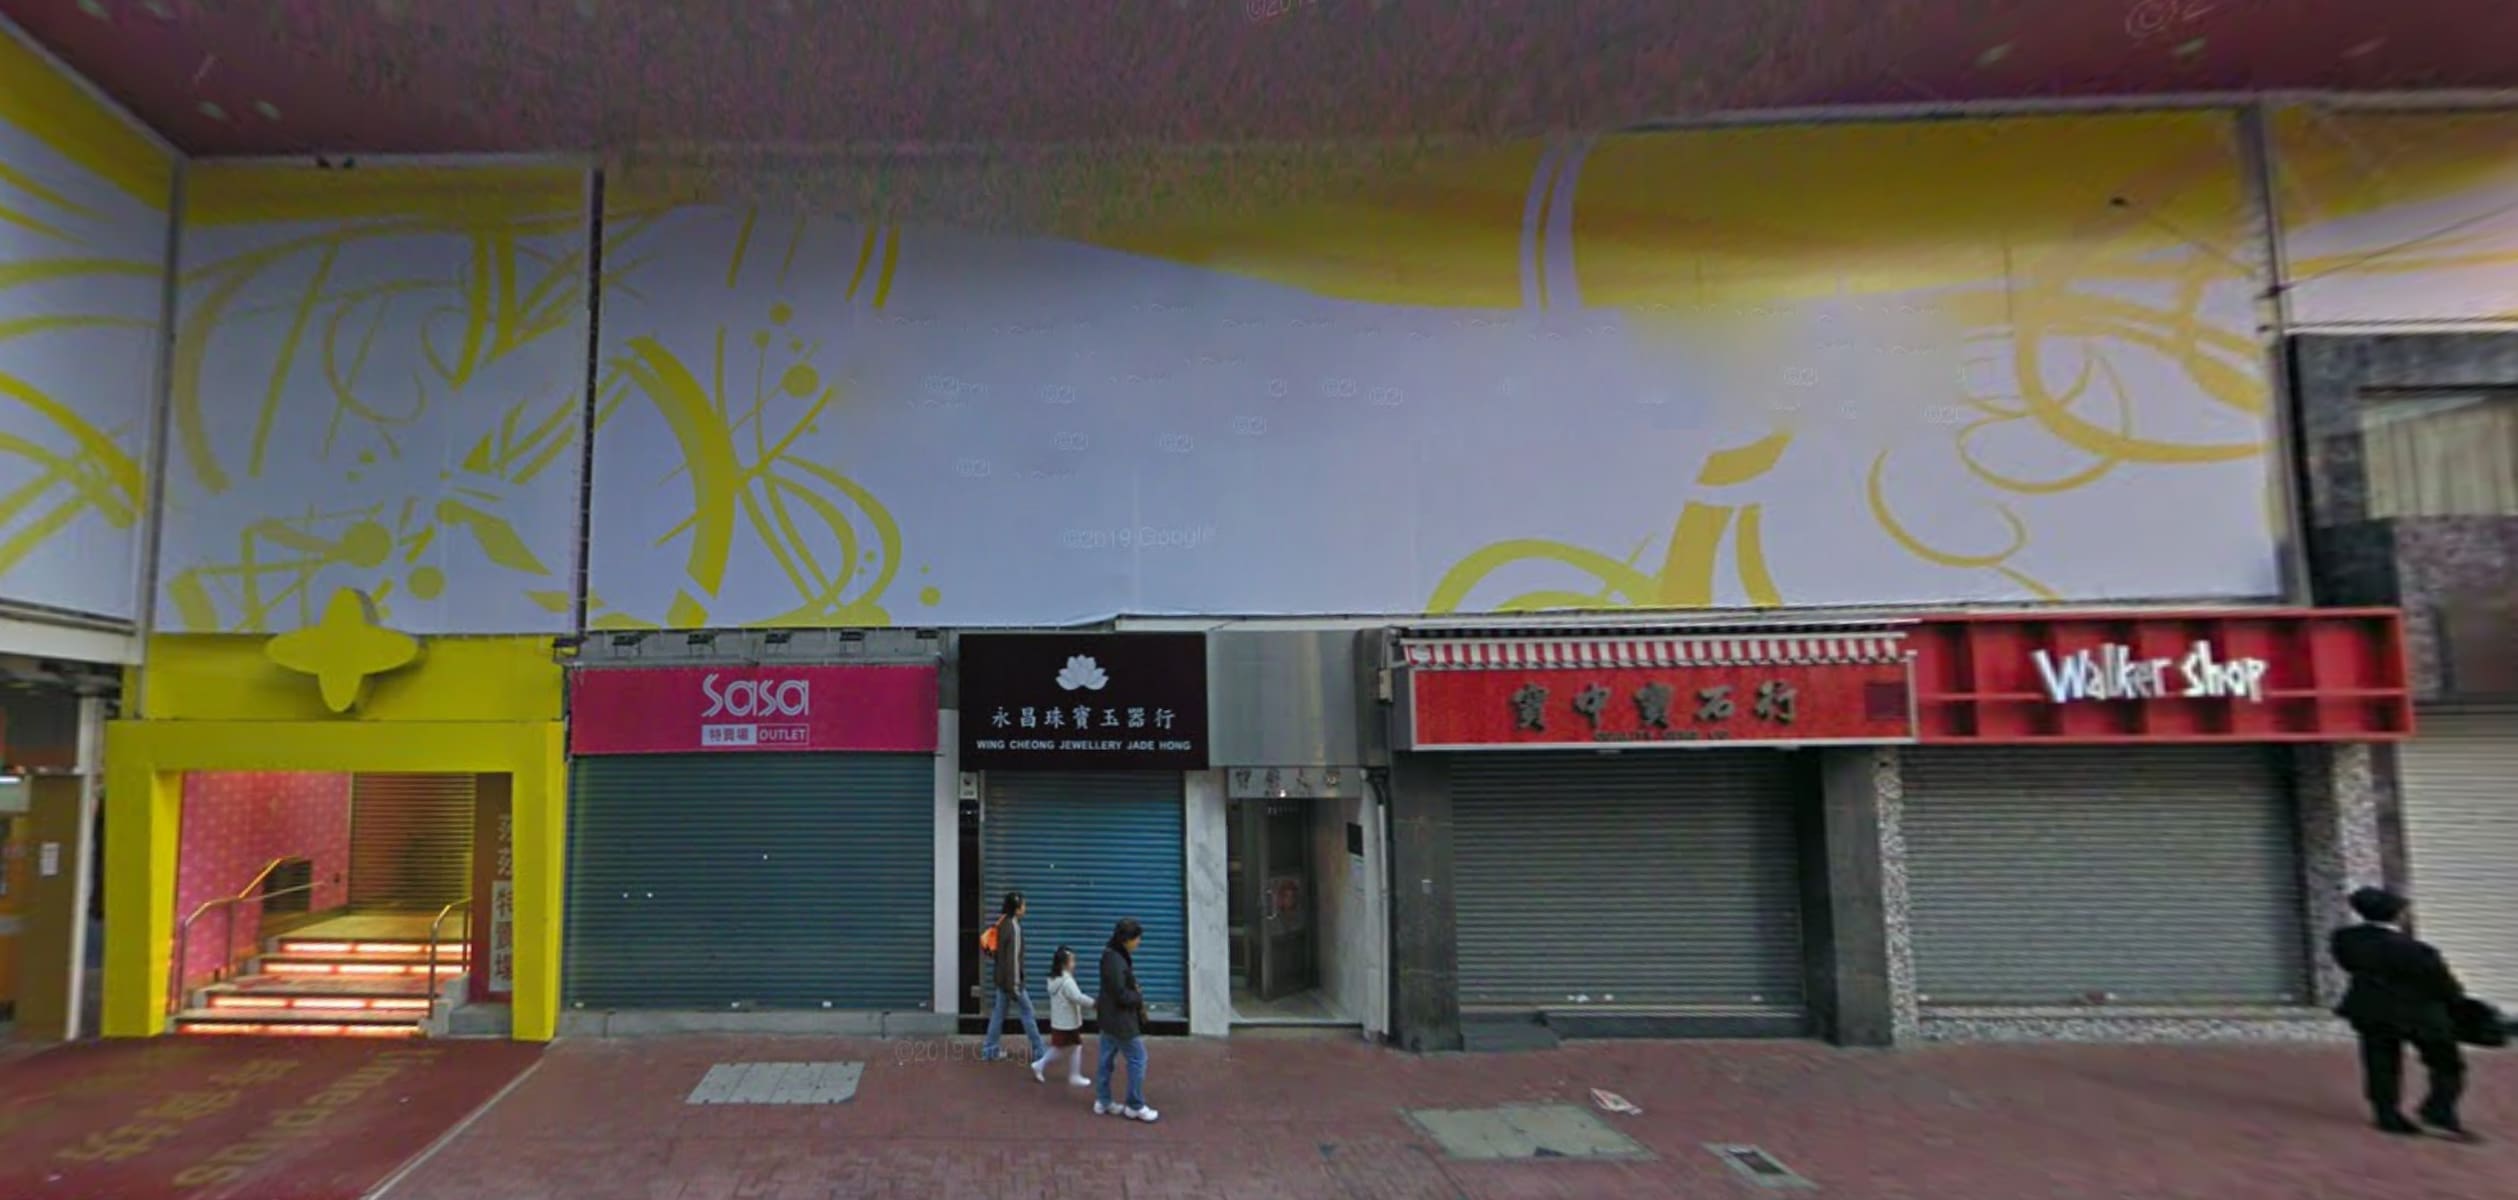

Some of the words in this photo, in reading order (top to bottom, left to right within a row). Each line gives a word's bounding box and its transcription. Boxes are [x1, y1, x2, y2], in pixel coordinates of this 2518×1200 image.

[2031, 642, 2172, 702] Walker
[991, 705, 1176, 730] 永昌珠寶玉器行
[759, 729, 806, 741] OUTLET
[976, 740, 1005, 750] WING
[1009, 740, 1054, 750] CHEONG
[1058, 740, 1122, 750] JEWELLERY
[1126, 740, 1154, 750] JADE
[1159, 740, 1191, 750] HONG
